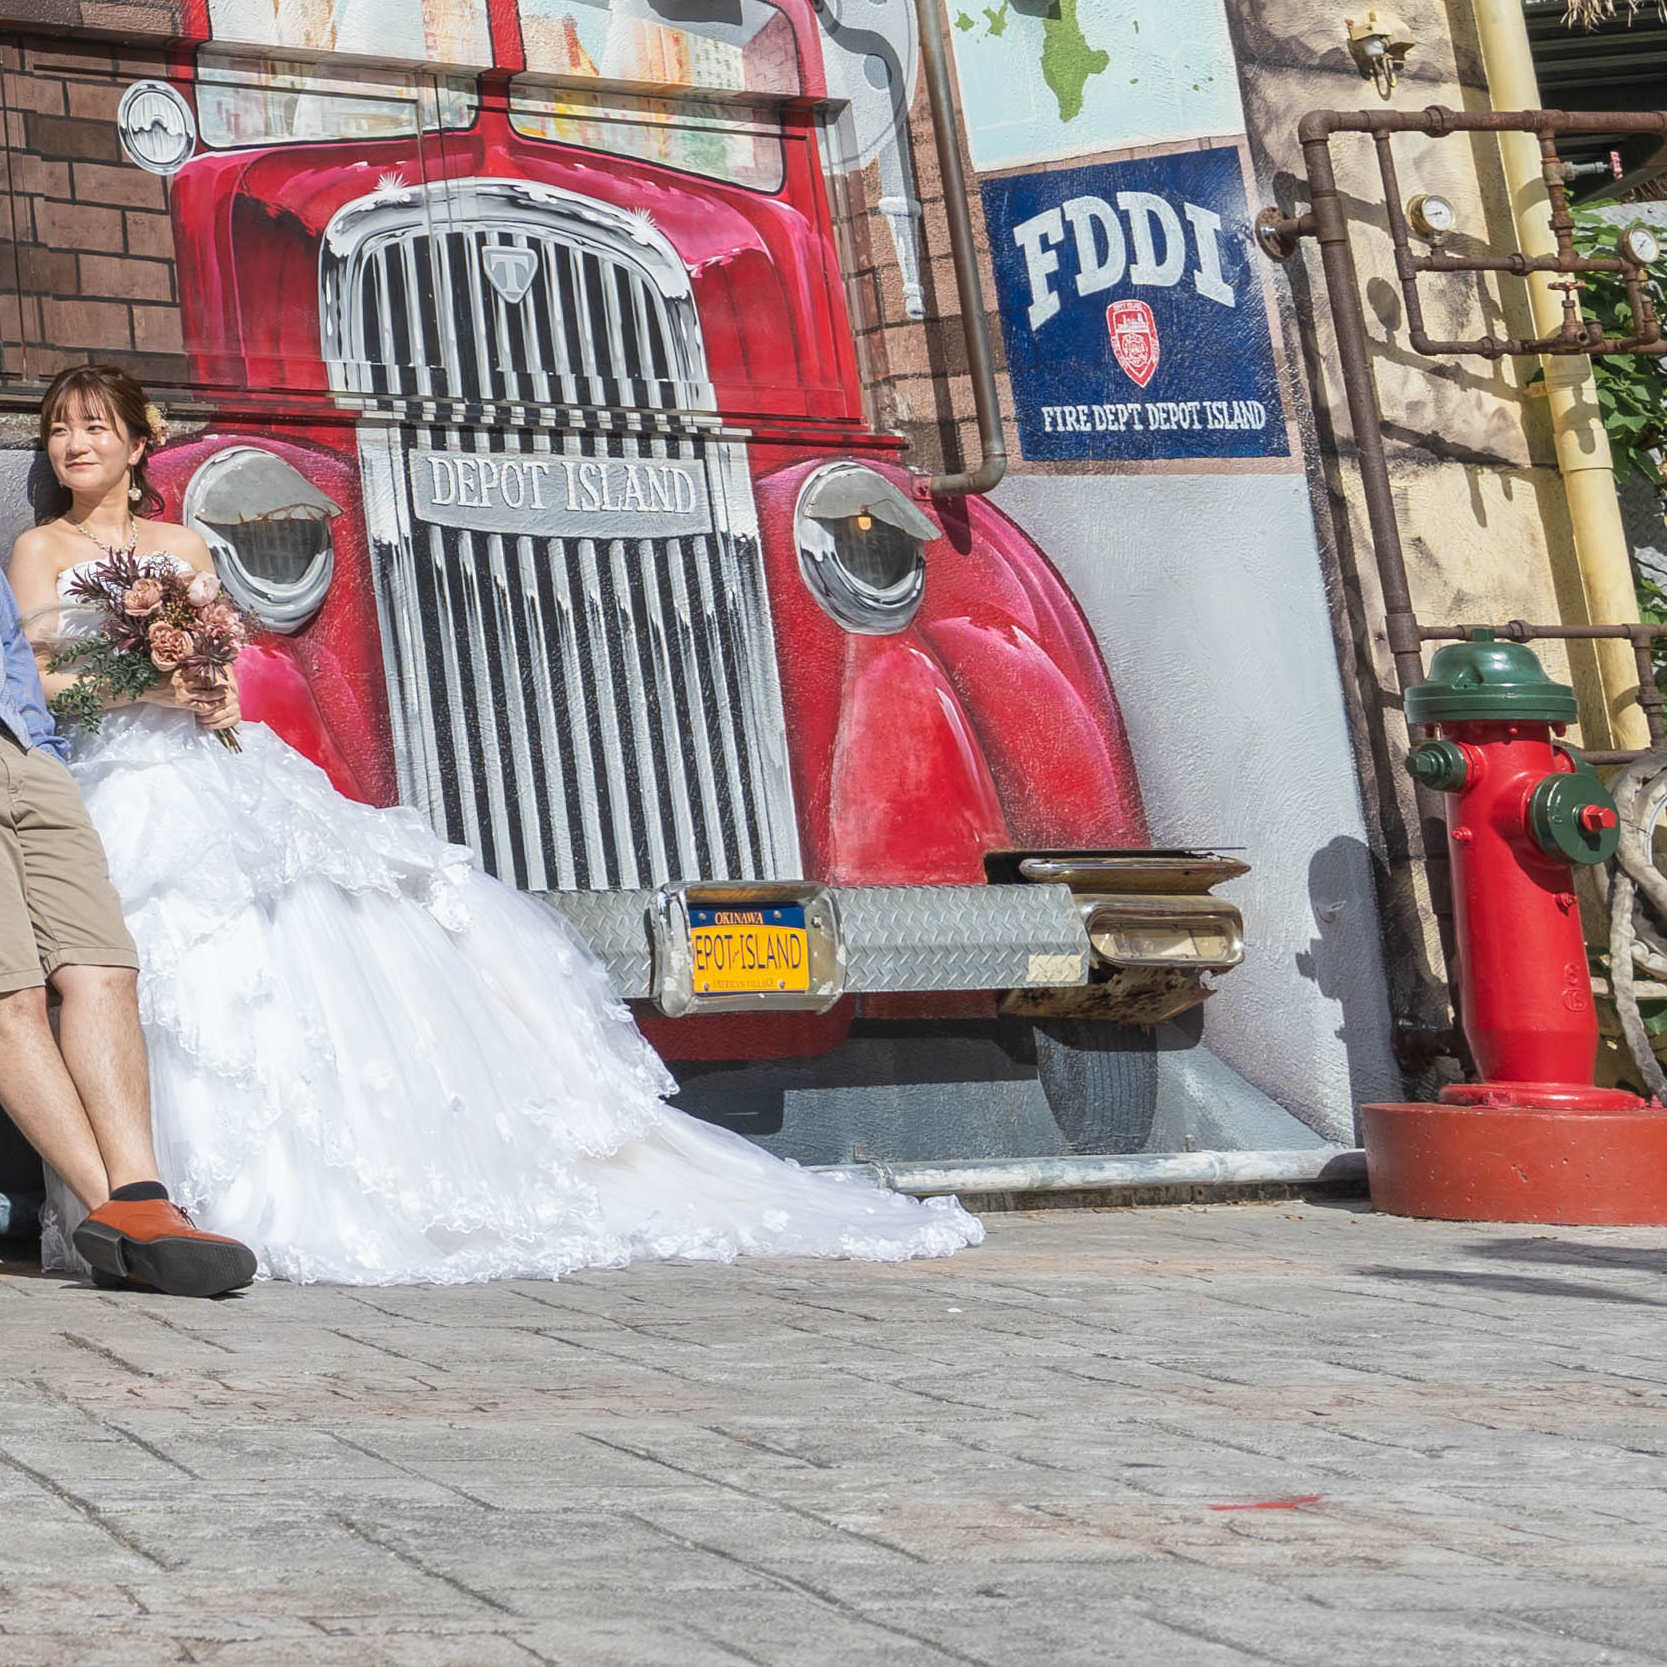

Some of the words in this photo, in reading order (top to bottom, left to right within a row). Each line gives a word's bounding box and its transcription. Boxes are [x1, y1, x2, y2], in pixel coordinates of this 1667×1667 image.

[1013, 191, 1236, 332] FDDI
[1041, 405, 1092, 432] FIRE
[1092, 403, 1144, 432] DEPT
[1145, 401, 1202, 431] DEPOT
[1202, 400, 1266, 431] ISLAND
[427, 456, 549, 510] DEPOT
[561, 461, 696, 514] ISLAND
[714, 911, 764, 925] OKINAWA
[693, 934, 733, 970] EPOT
[739, 933, 802, 969] ISLAND
